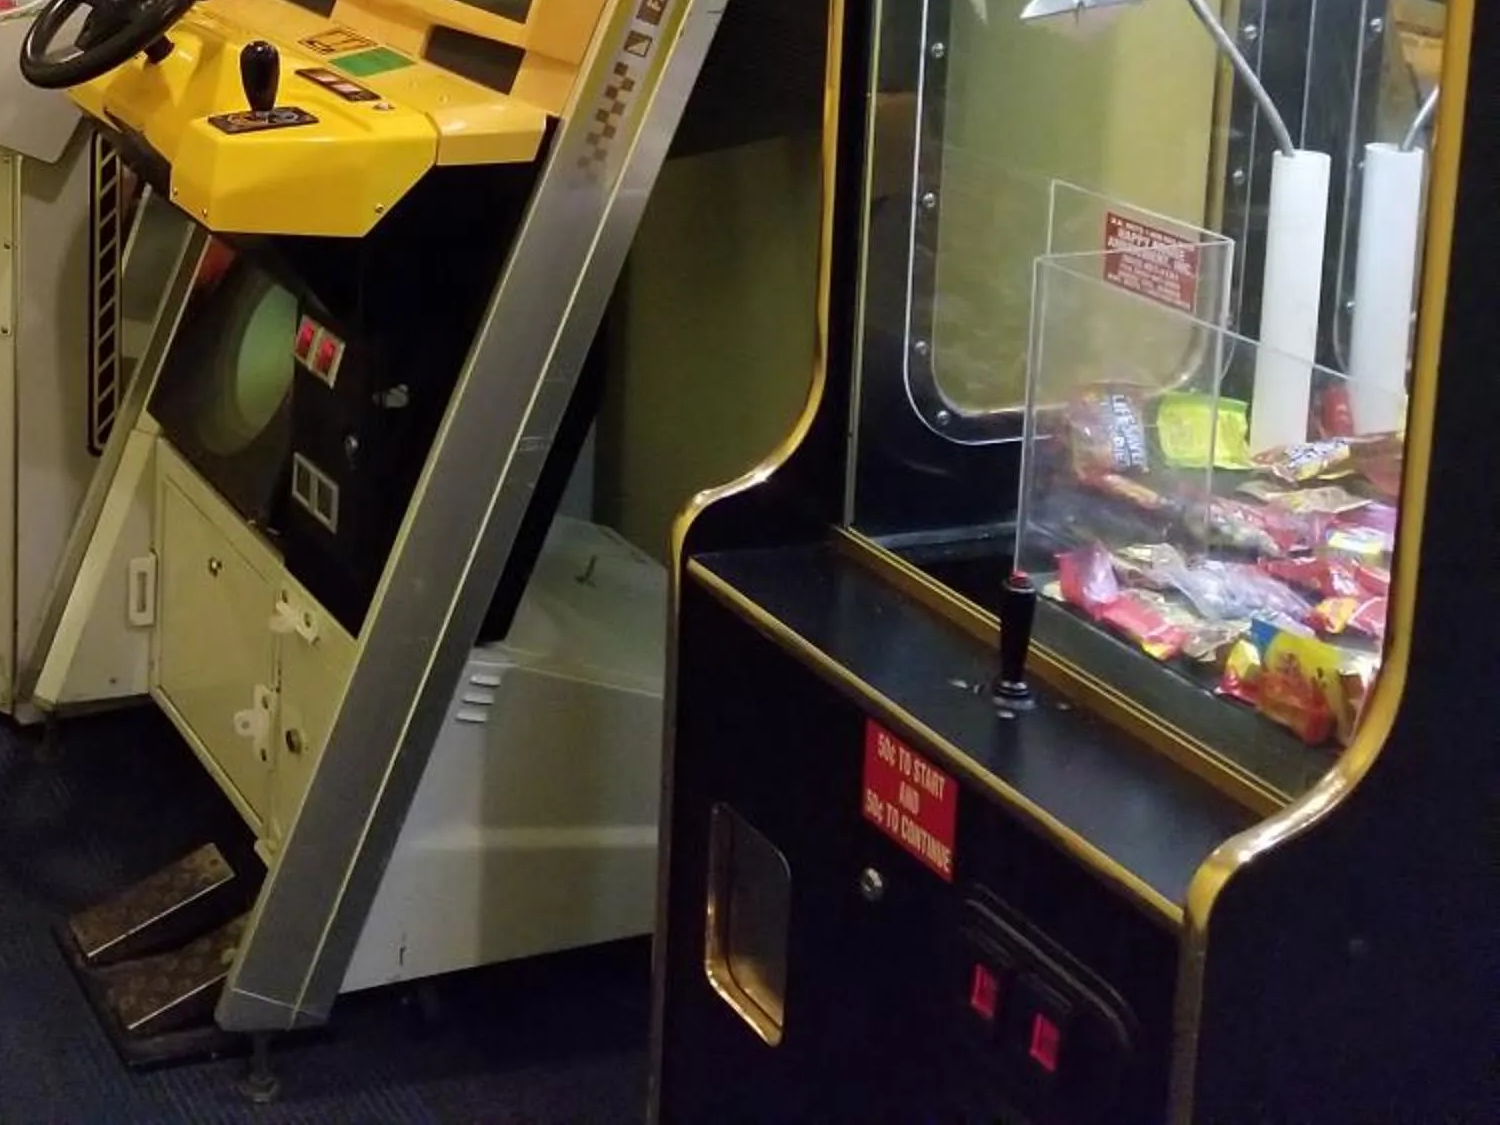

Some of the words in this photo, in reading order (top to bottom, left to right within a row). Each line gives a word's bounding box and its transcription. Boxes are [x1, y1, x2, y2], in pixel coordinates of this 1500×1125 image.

[898, 746, 912, 776] TO
[913, 758, 946, 802] START
[899, 780, 920, 815] AND
[886, 802, 900, 833] TO
[901, 813, 953, 874] CONTINUE
